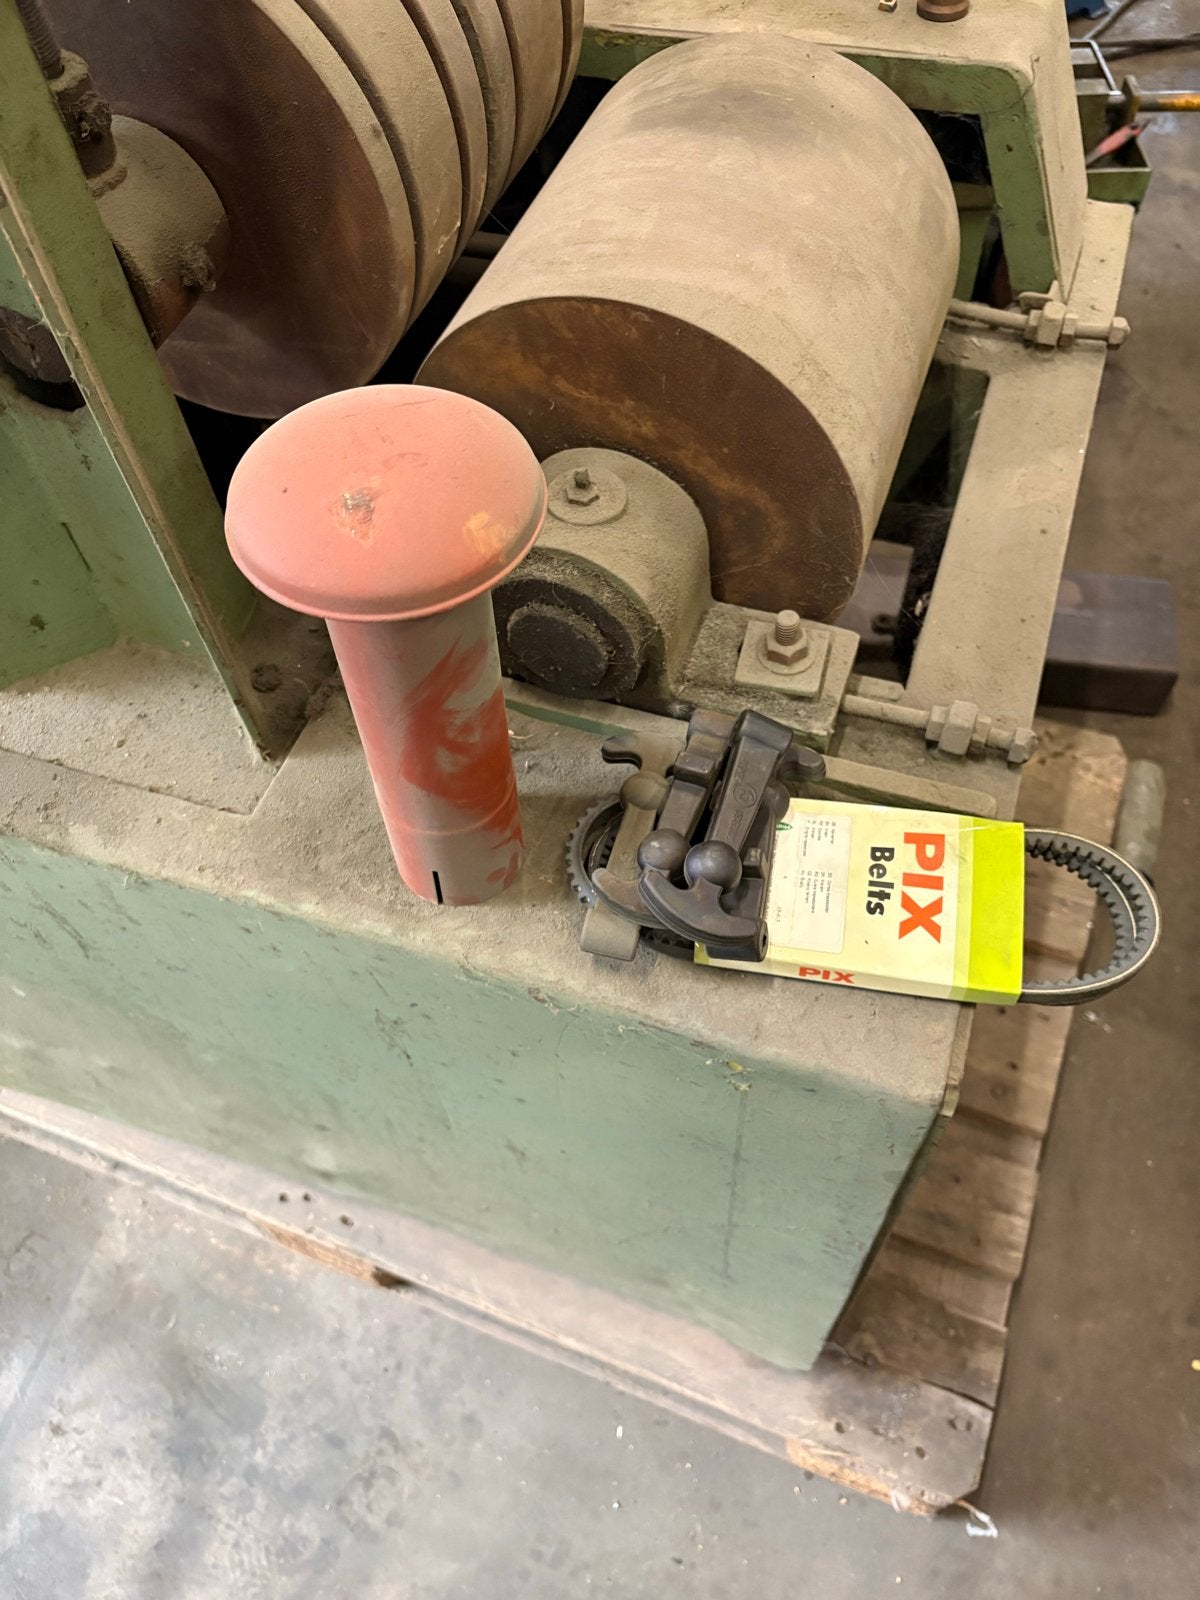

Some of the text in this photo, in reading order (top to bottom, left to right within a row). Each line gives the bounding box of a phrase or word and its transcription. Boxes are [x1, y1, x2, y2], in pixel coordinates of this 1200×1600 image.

[866, 847, 895, 916] Belts
[899, 832, 945, 944] PIX
[799, 966, 856, 984] PIX
